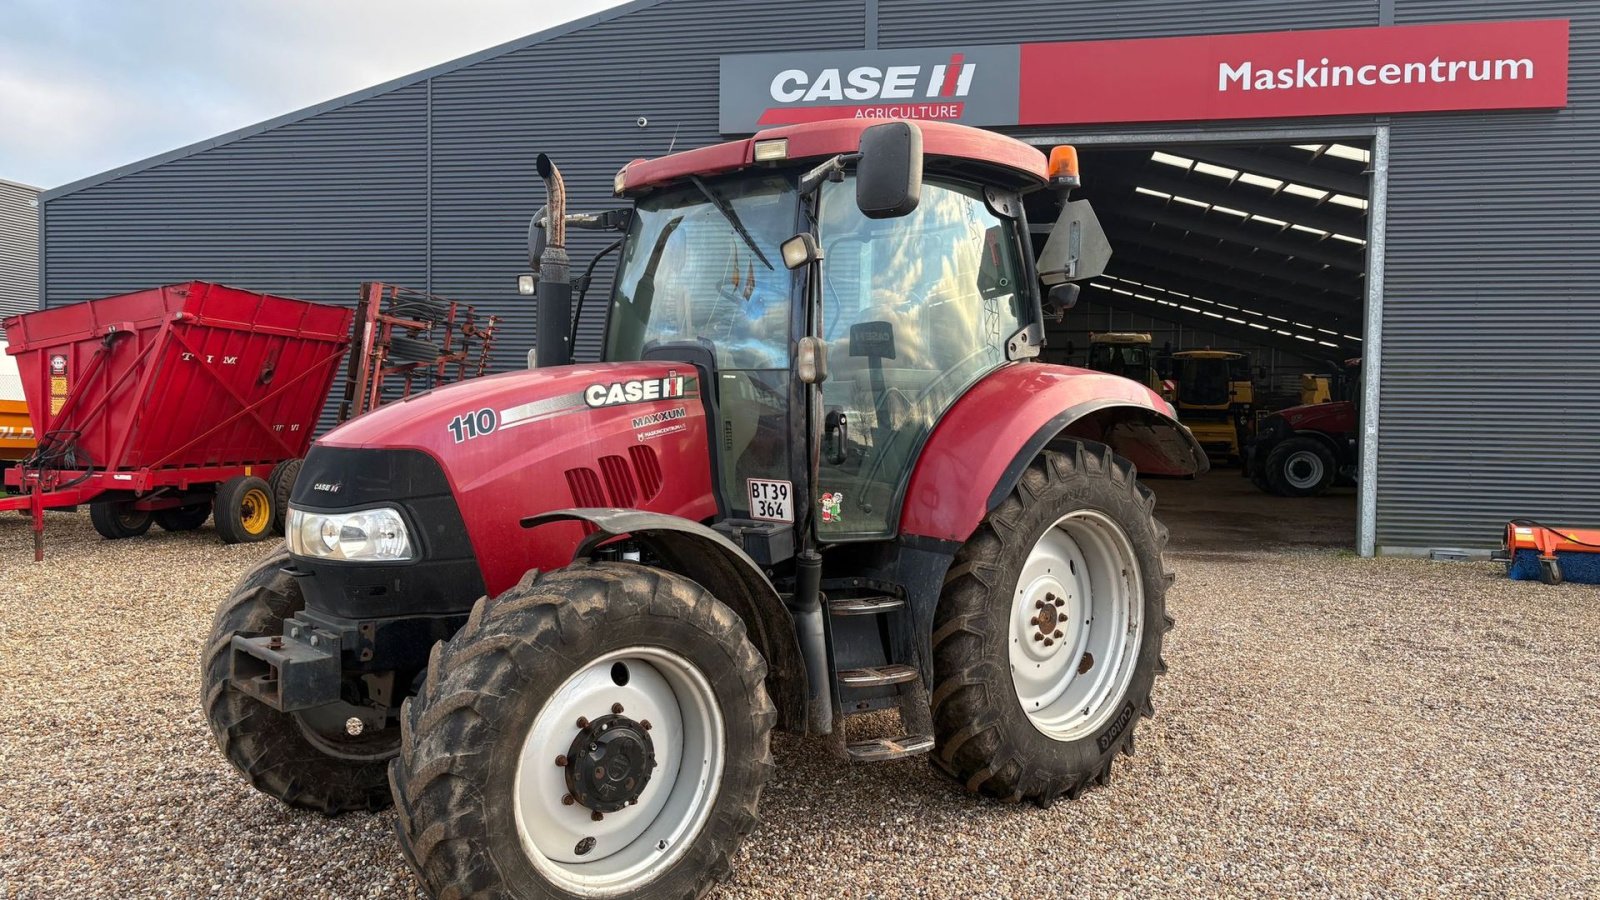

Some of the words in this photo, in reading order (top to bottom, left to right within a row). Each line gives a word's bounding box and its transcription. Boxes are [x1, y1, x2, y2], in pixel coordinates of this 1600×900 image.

[770, 65, 920, 102] CASE
[1218, 56, 1534, 91] Maskincentrum
[854, 104, 958, 120] AGRICULTURE
[586, 379, 660, 407] CASE
[448, 407, 496, 444] 110
[632, 407, 686, 429] MAXXUM
[314, 483, 331, 491] CASE
[751, 482, 787, 500] BT39
[758, 500, 784, 519] 364
